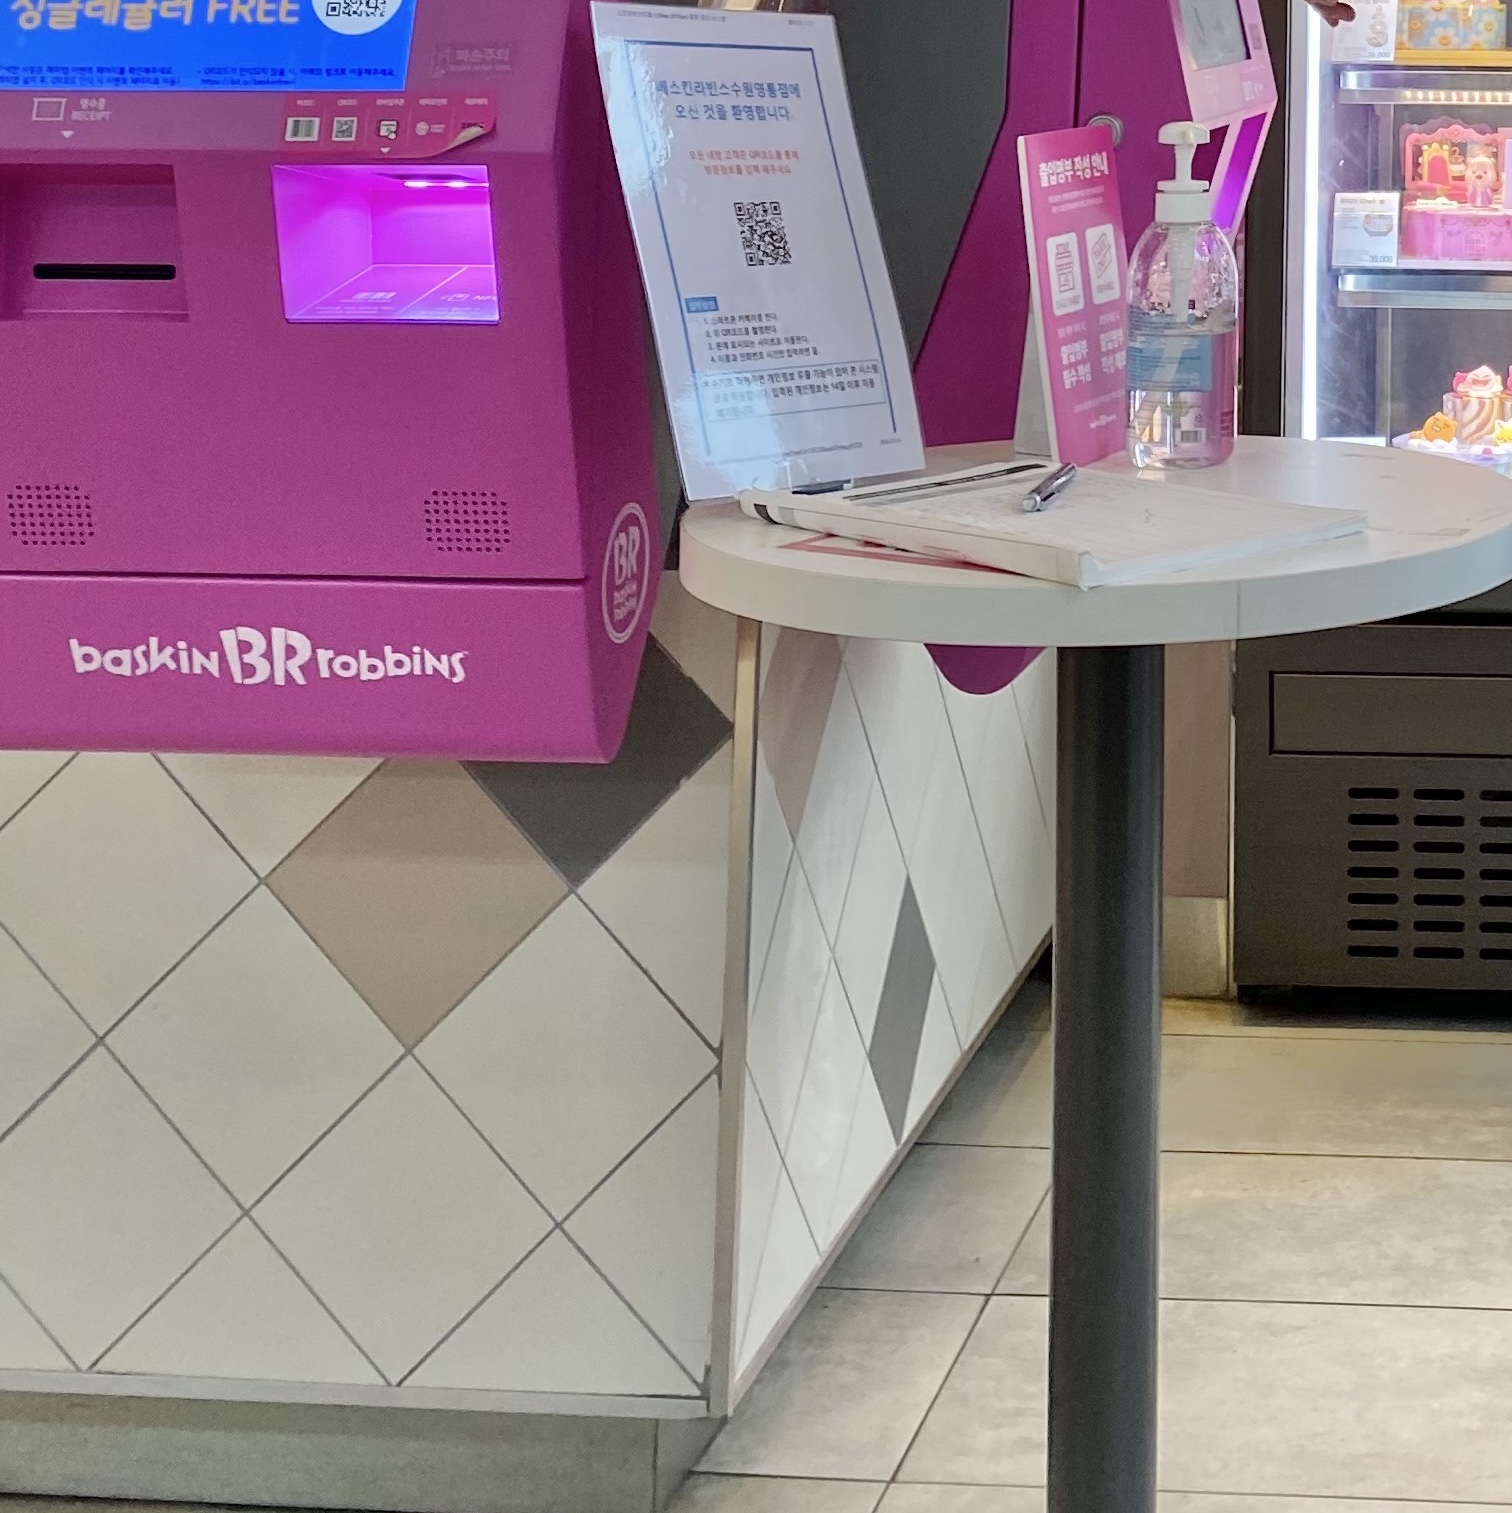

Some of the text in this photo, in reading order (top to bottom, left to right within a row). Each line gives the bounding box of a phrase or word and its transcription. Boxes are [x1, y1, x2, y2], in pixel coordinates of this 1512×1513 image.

[71, 110, 112, 122] RECEIPT
[675, 104, 699, 120] 오신
[703, 104, 727, 120] 것을
[614, 526, 641, 586] BR
[69, 626, 467, 686] baskin BR robbins
